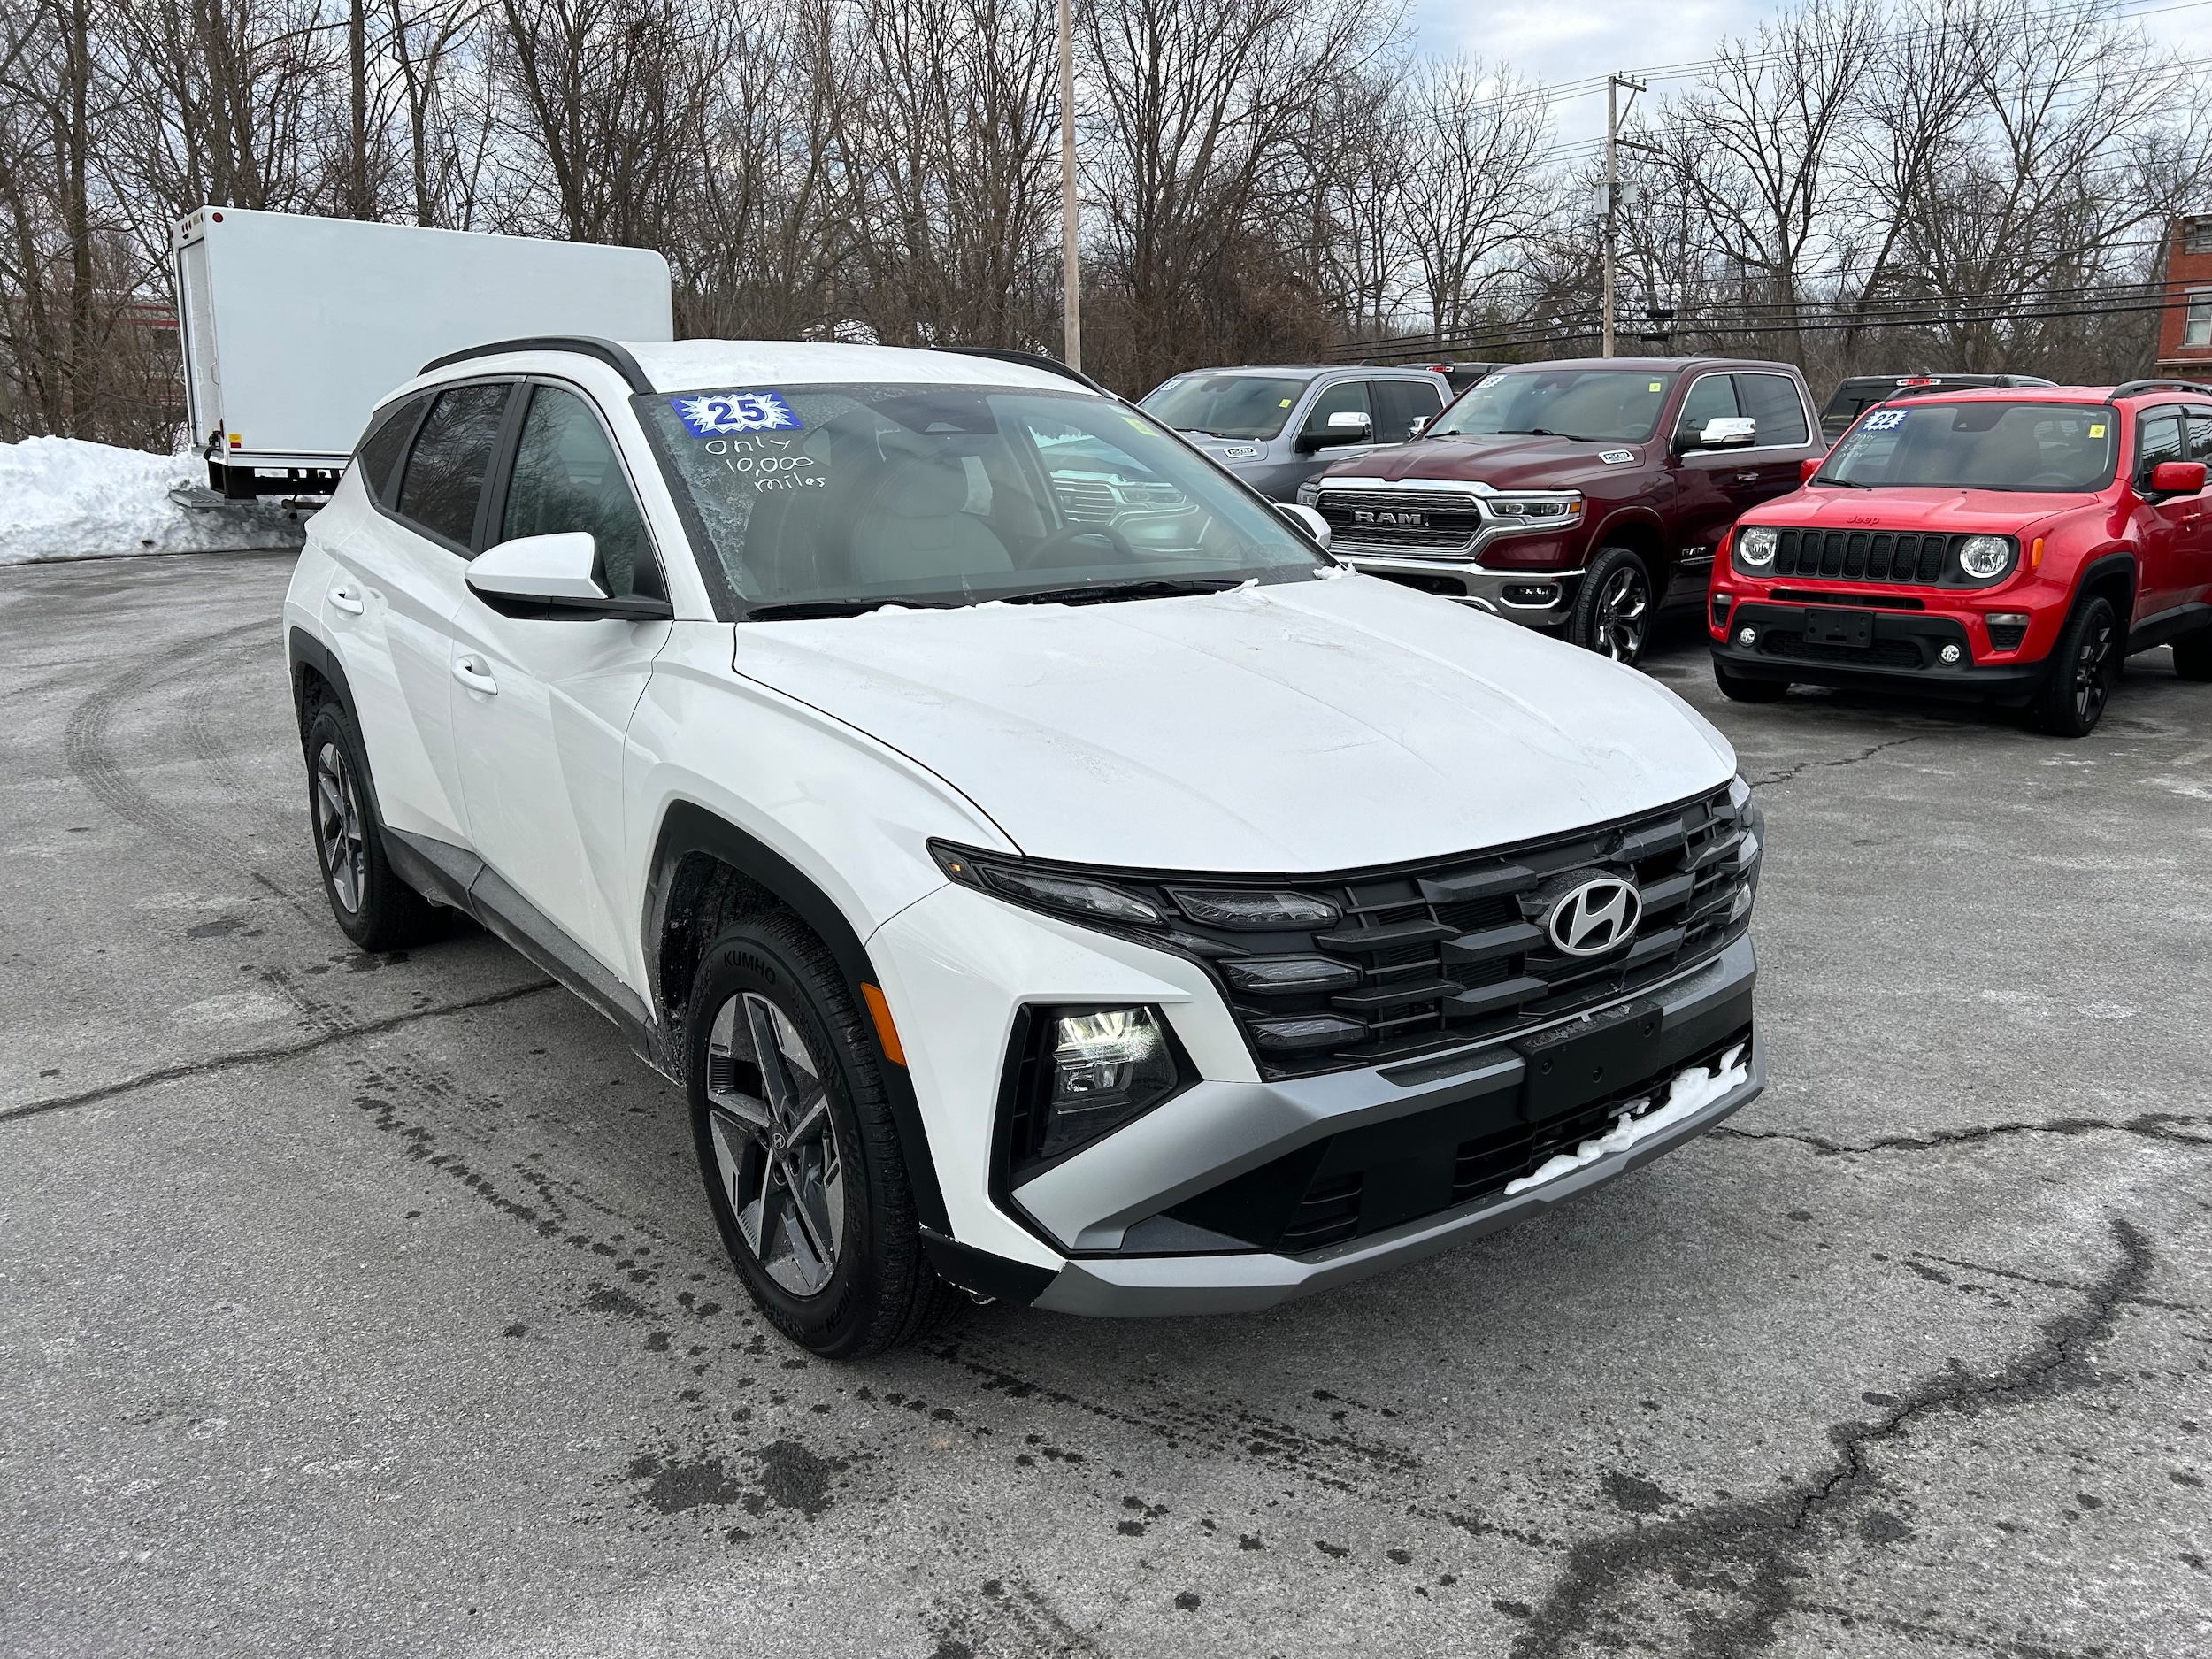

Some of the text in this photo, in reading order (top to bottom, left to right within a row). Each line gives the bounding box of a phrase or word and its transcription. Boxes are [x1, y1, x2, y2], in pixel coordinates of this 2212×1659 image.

[707, 398, 765, 426] 25
[1870, 412, 1899, 426] 22
[726, 457, 814, 478] 10,000
[754, 472, 826, 493] miles
[1354, 511, 1422, 525] RAM
[1846, 515, 1880, 526] Jeep
[723, 949, 777, 986] KUMHO
